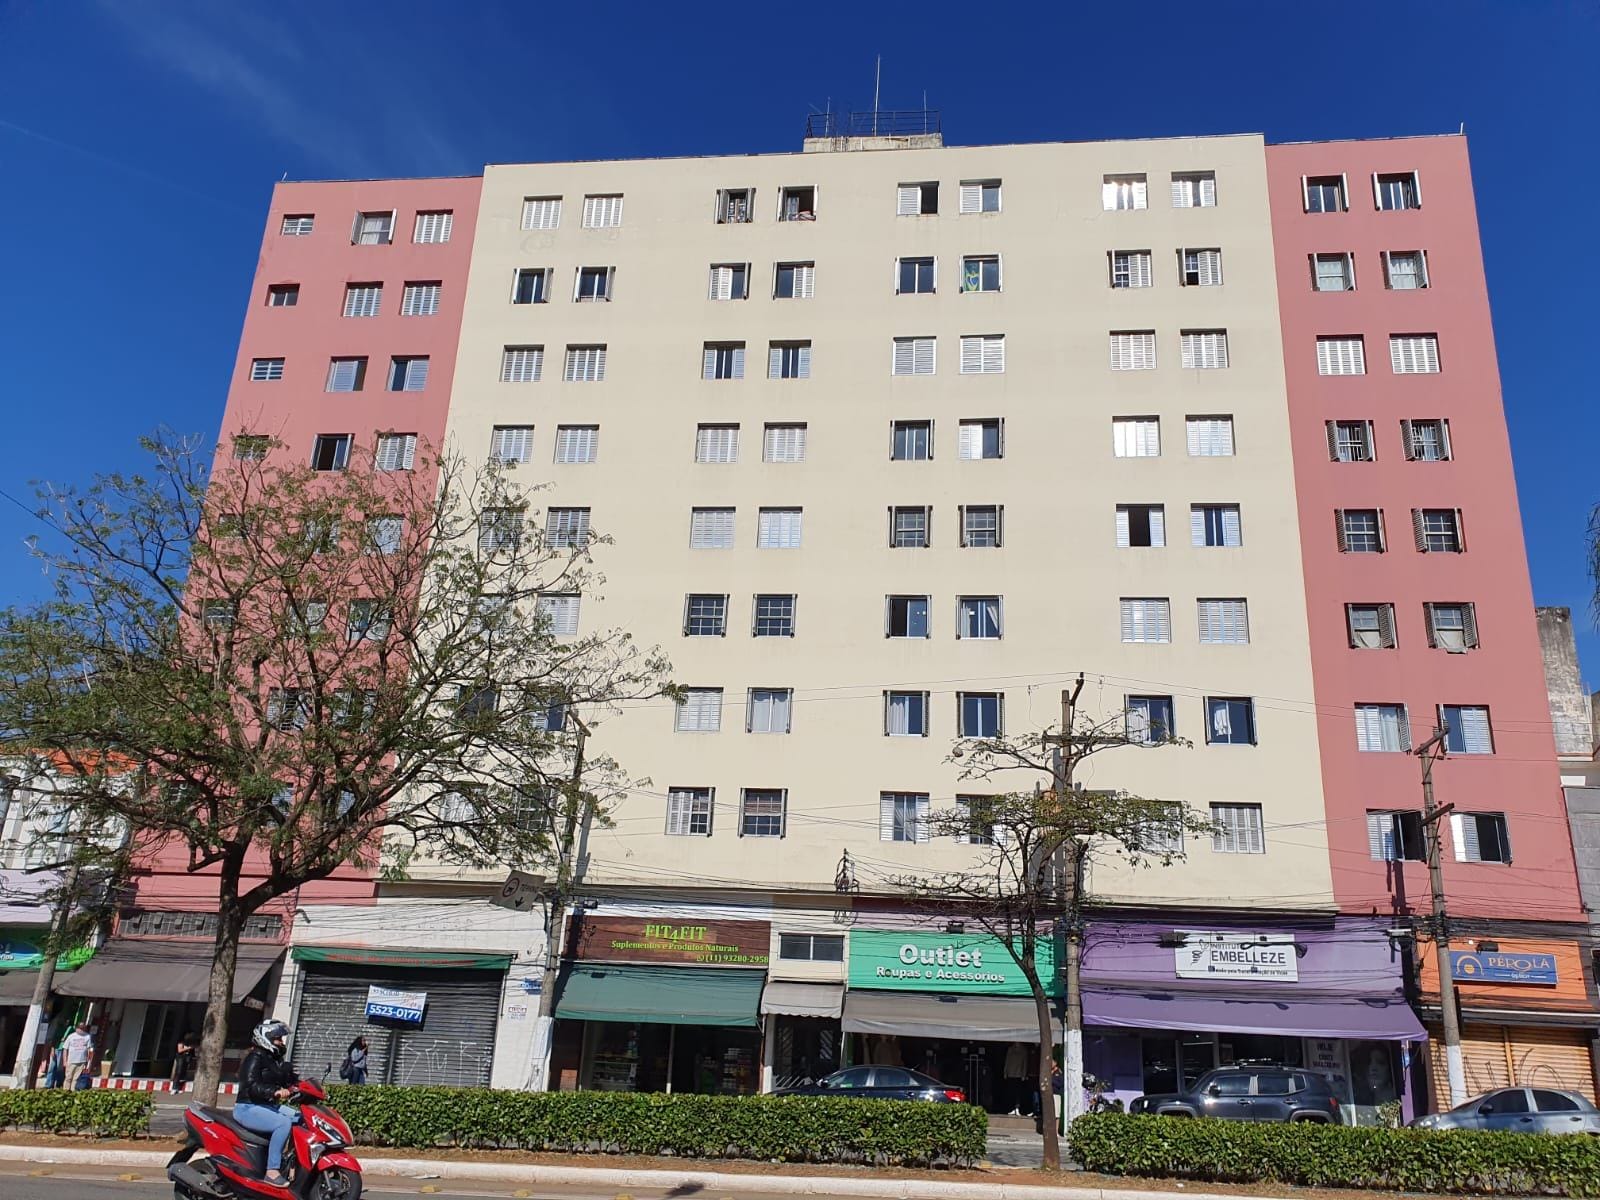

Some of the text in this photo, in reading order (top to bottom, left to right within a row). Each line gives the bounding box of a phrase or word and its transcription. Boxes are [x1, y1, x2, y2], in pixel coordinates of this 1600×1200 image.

[645, 923, 707, 943] FIT4FIT
[611, 939, 661, 951] Suplementos
[668, 942, 705, 952] Produtos
[705, 944, 739, 953] Naturais
[1210, 943, 1247, 951] INSTITUT
[705, 954, 769, 964] (11) 93280-2958
[899, 943, 982, 968] Outlet
[1211, 950, 1286, 964] EMBELLEZE
[1488, 955, 1550, 973] PÉROLA
[876, 965, 921, 980] Roupas
[925, 970, 933, 979] e
[368, 1004, 421, 1020] 5523-0177
